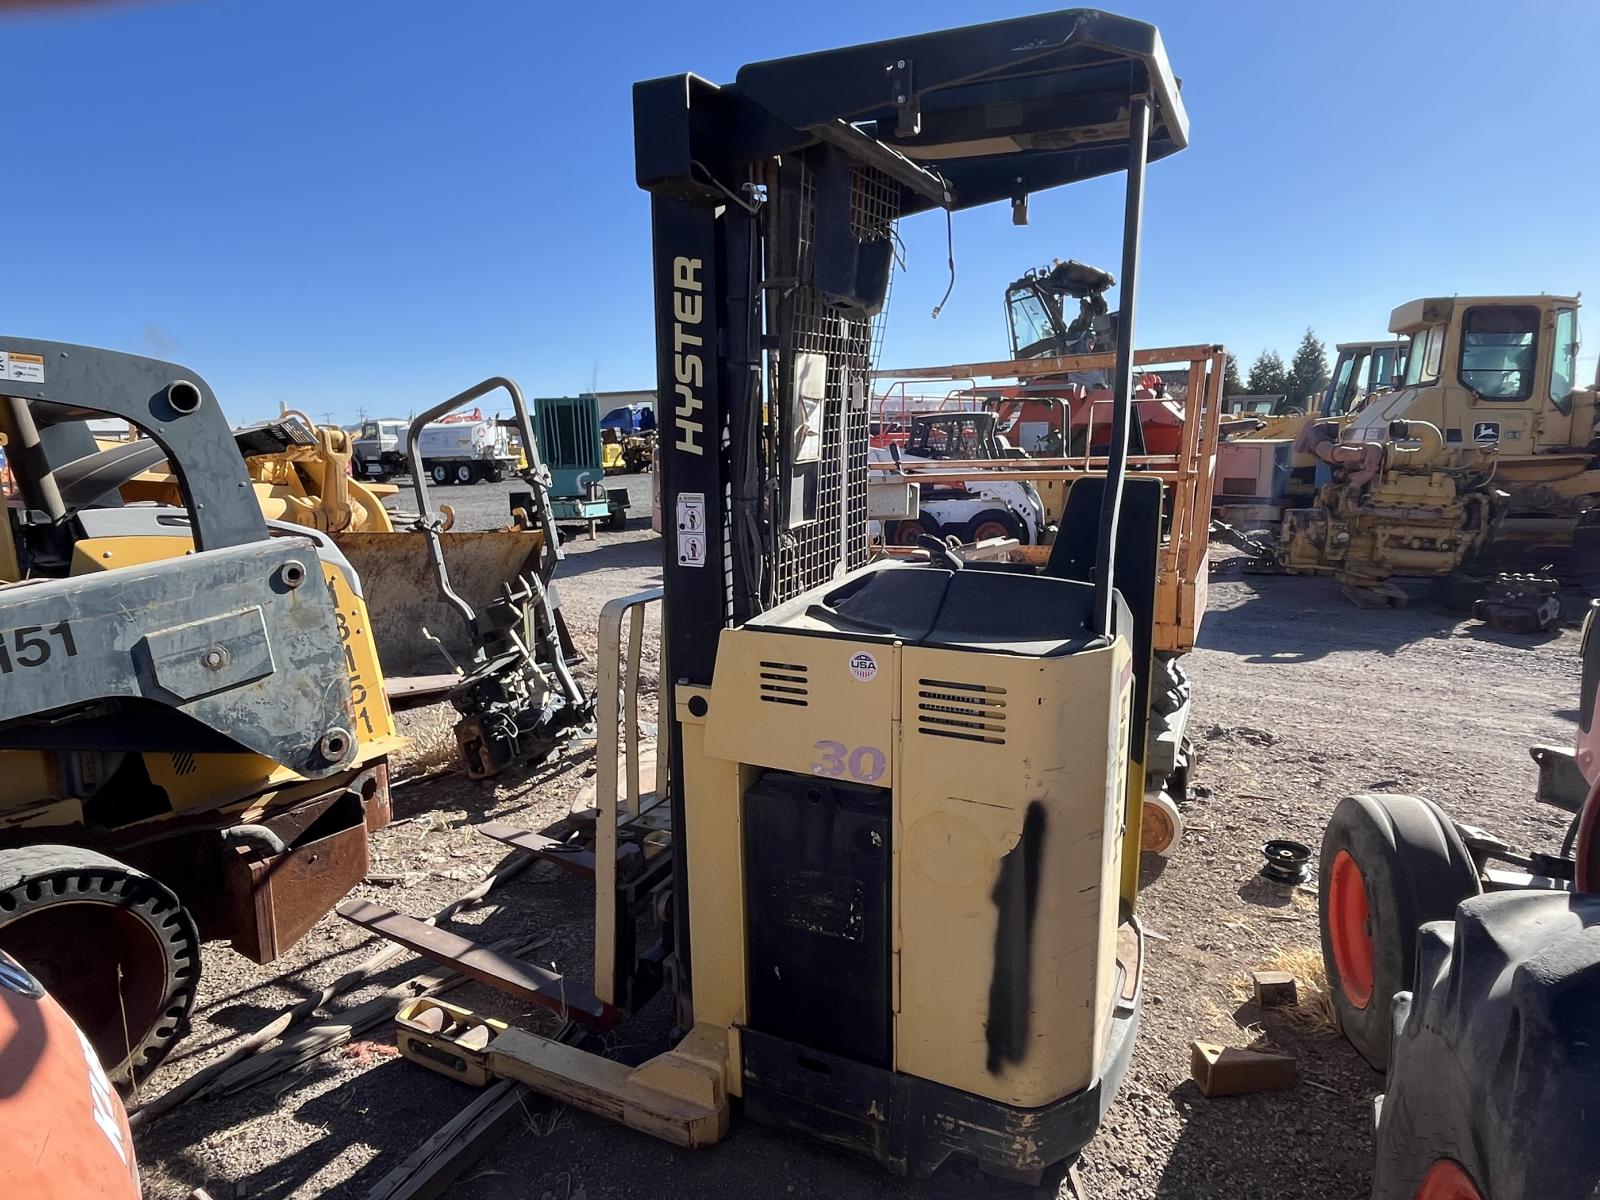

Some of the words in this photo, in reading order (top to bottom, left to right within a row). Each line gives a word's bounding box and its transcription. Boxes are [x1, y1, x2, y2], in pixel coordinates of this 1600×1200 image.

[673, 256, 703, 456] HYSTER
[851, 660, 876, 670] USA
[810, 740, 886, 782] 30
